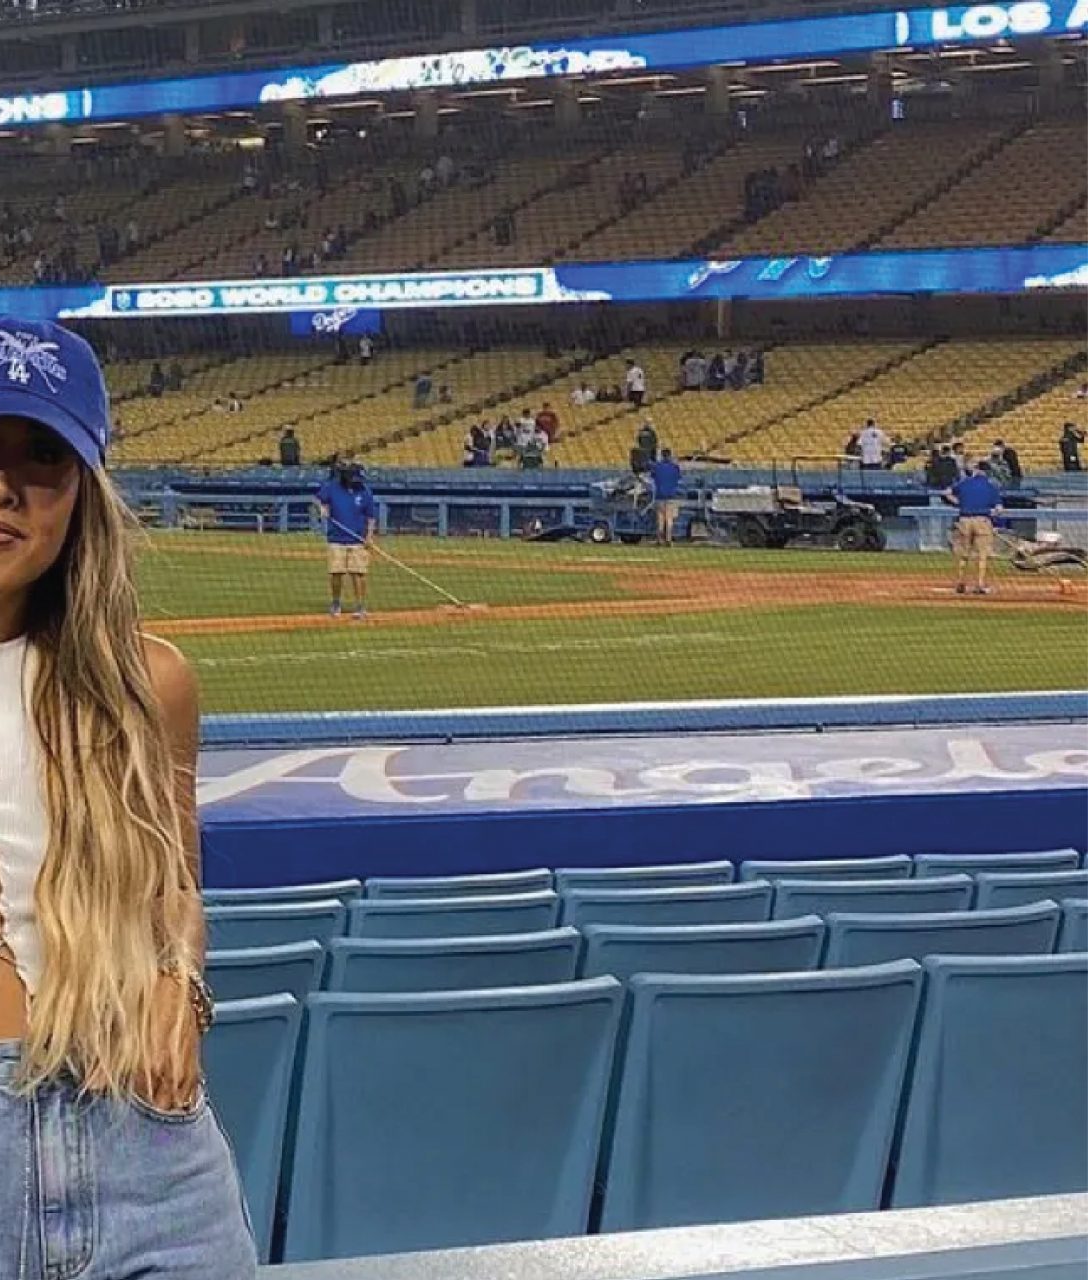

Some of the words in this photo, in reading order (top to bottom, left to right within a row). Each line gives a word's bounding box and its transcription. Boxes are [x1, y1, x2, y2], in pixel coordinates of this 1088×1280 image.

[932, 1, 1051, 39] LOS
[220, 280, 327, 307] WORLD
[333, 276, 536, 304] CHAMPIONS
